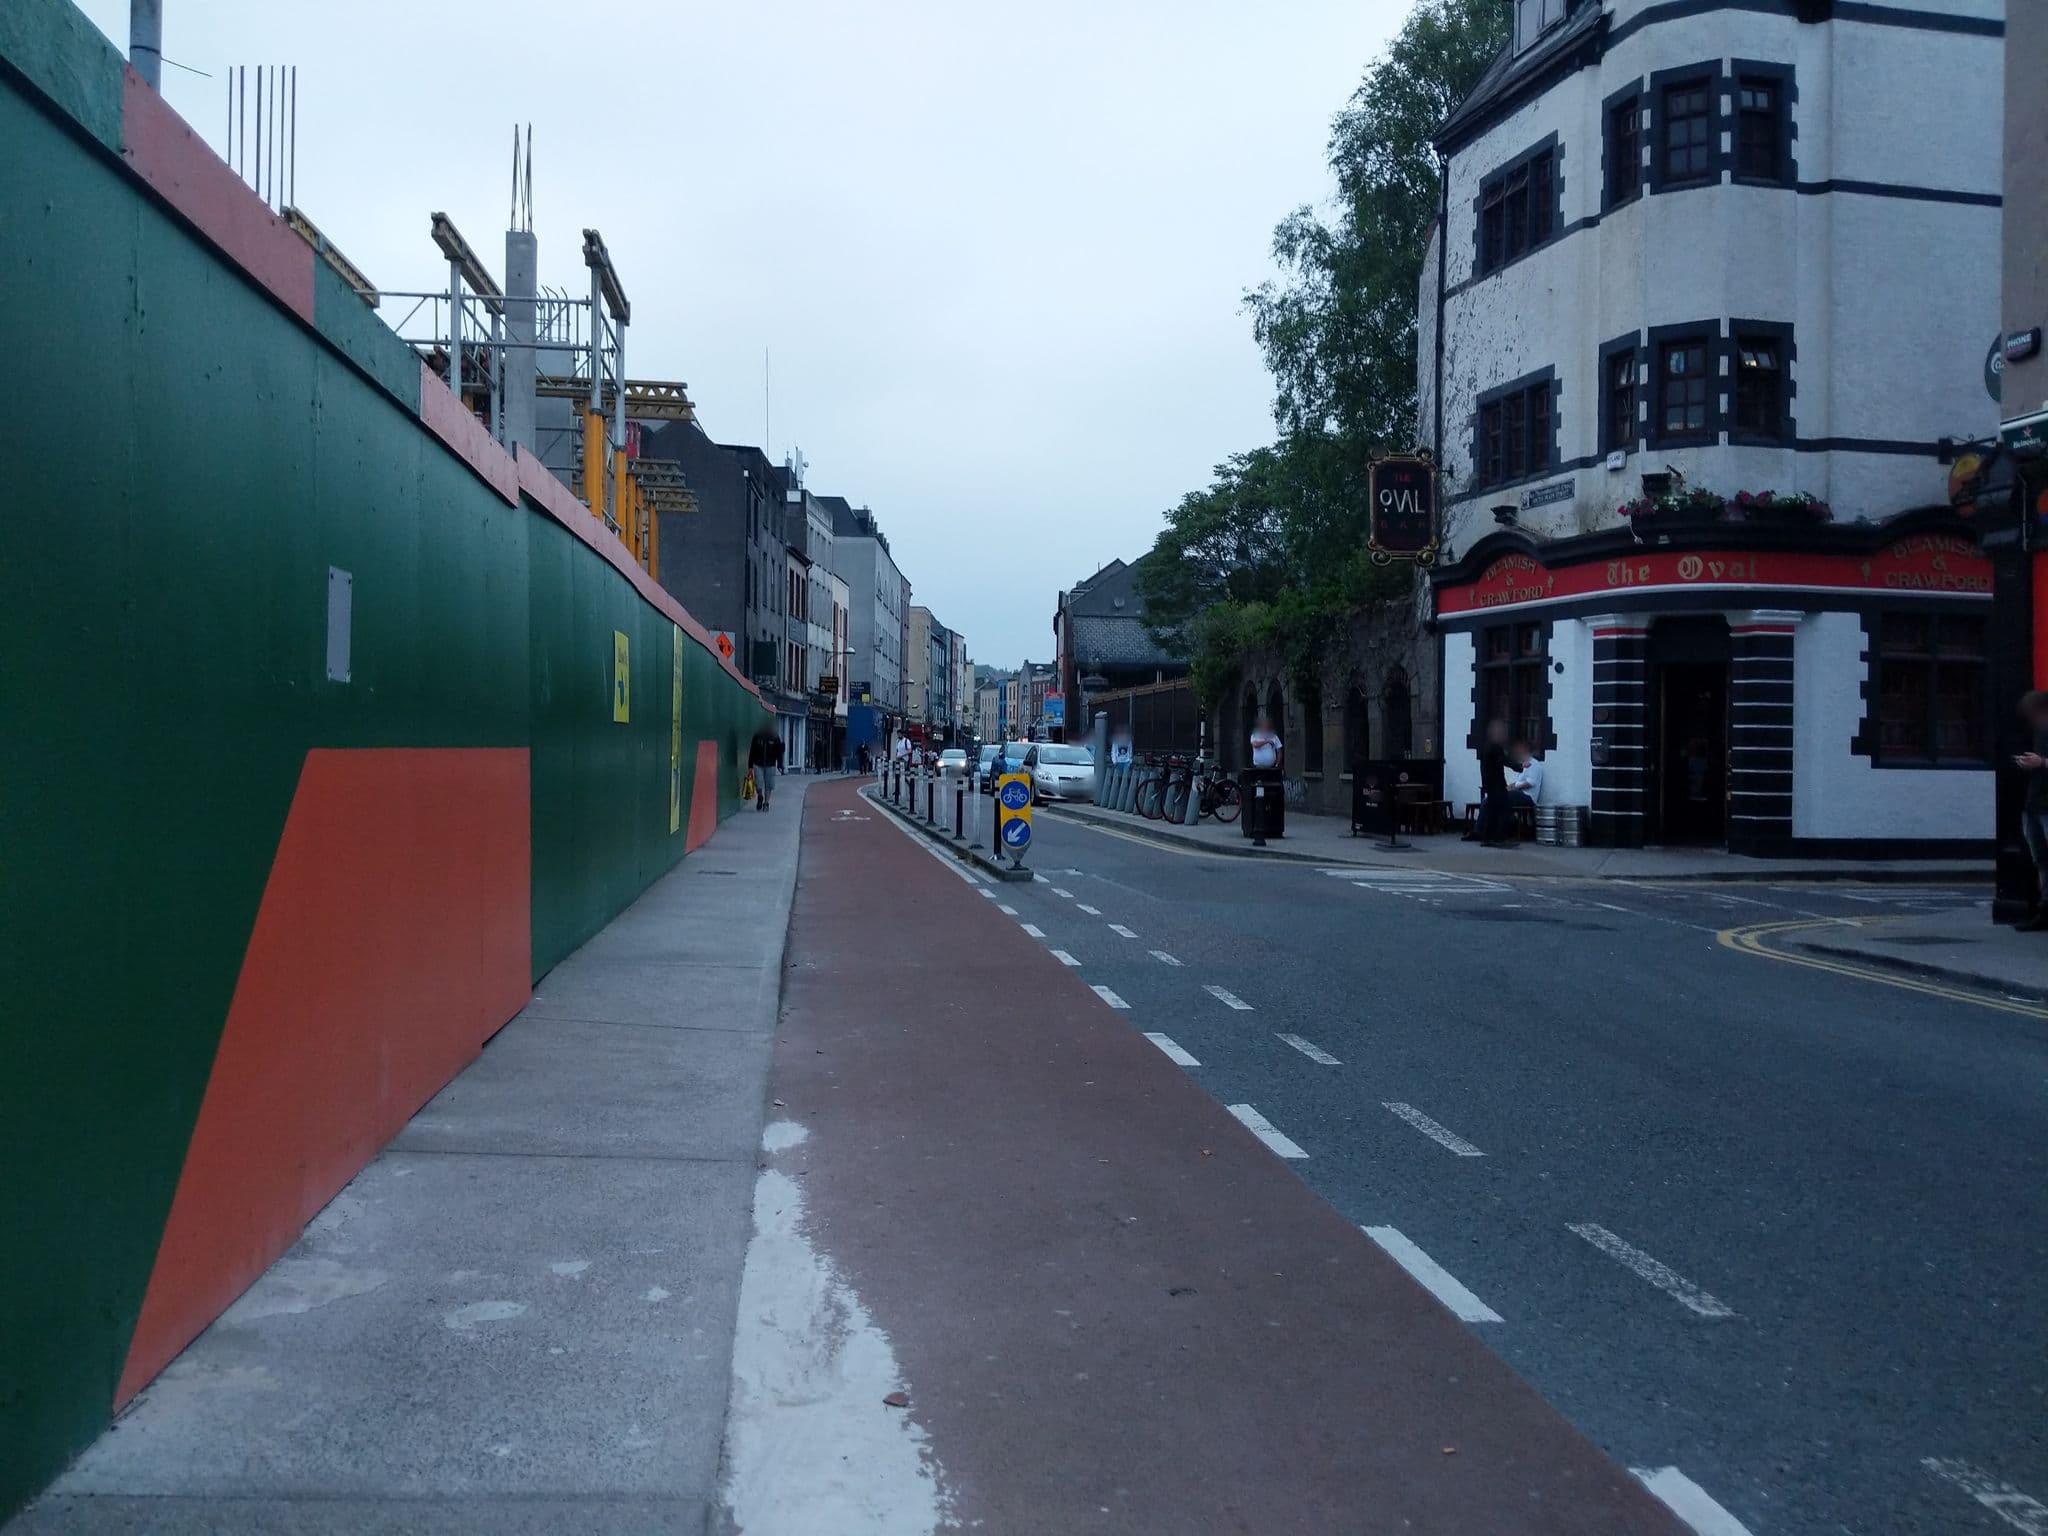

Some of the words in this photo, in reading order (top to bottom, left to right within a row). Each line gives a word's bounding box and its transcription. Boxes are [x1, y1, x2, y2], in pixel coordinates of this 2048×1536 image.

[2006, 332, 2032, 350] PHONE
[1379, 488, 1426, 513] OVAL
[1486, 556, 1537, 581] BEAMISH
[1506, 571, 1514, 586] &
[1606, 560, 1650, 585] The
[1677, 555, 1759, 581] Oval
[1886, 572, 1990, 591] CRAWFORD
[1480, 585, 1544, 606] CRAWFORD
